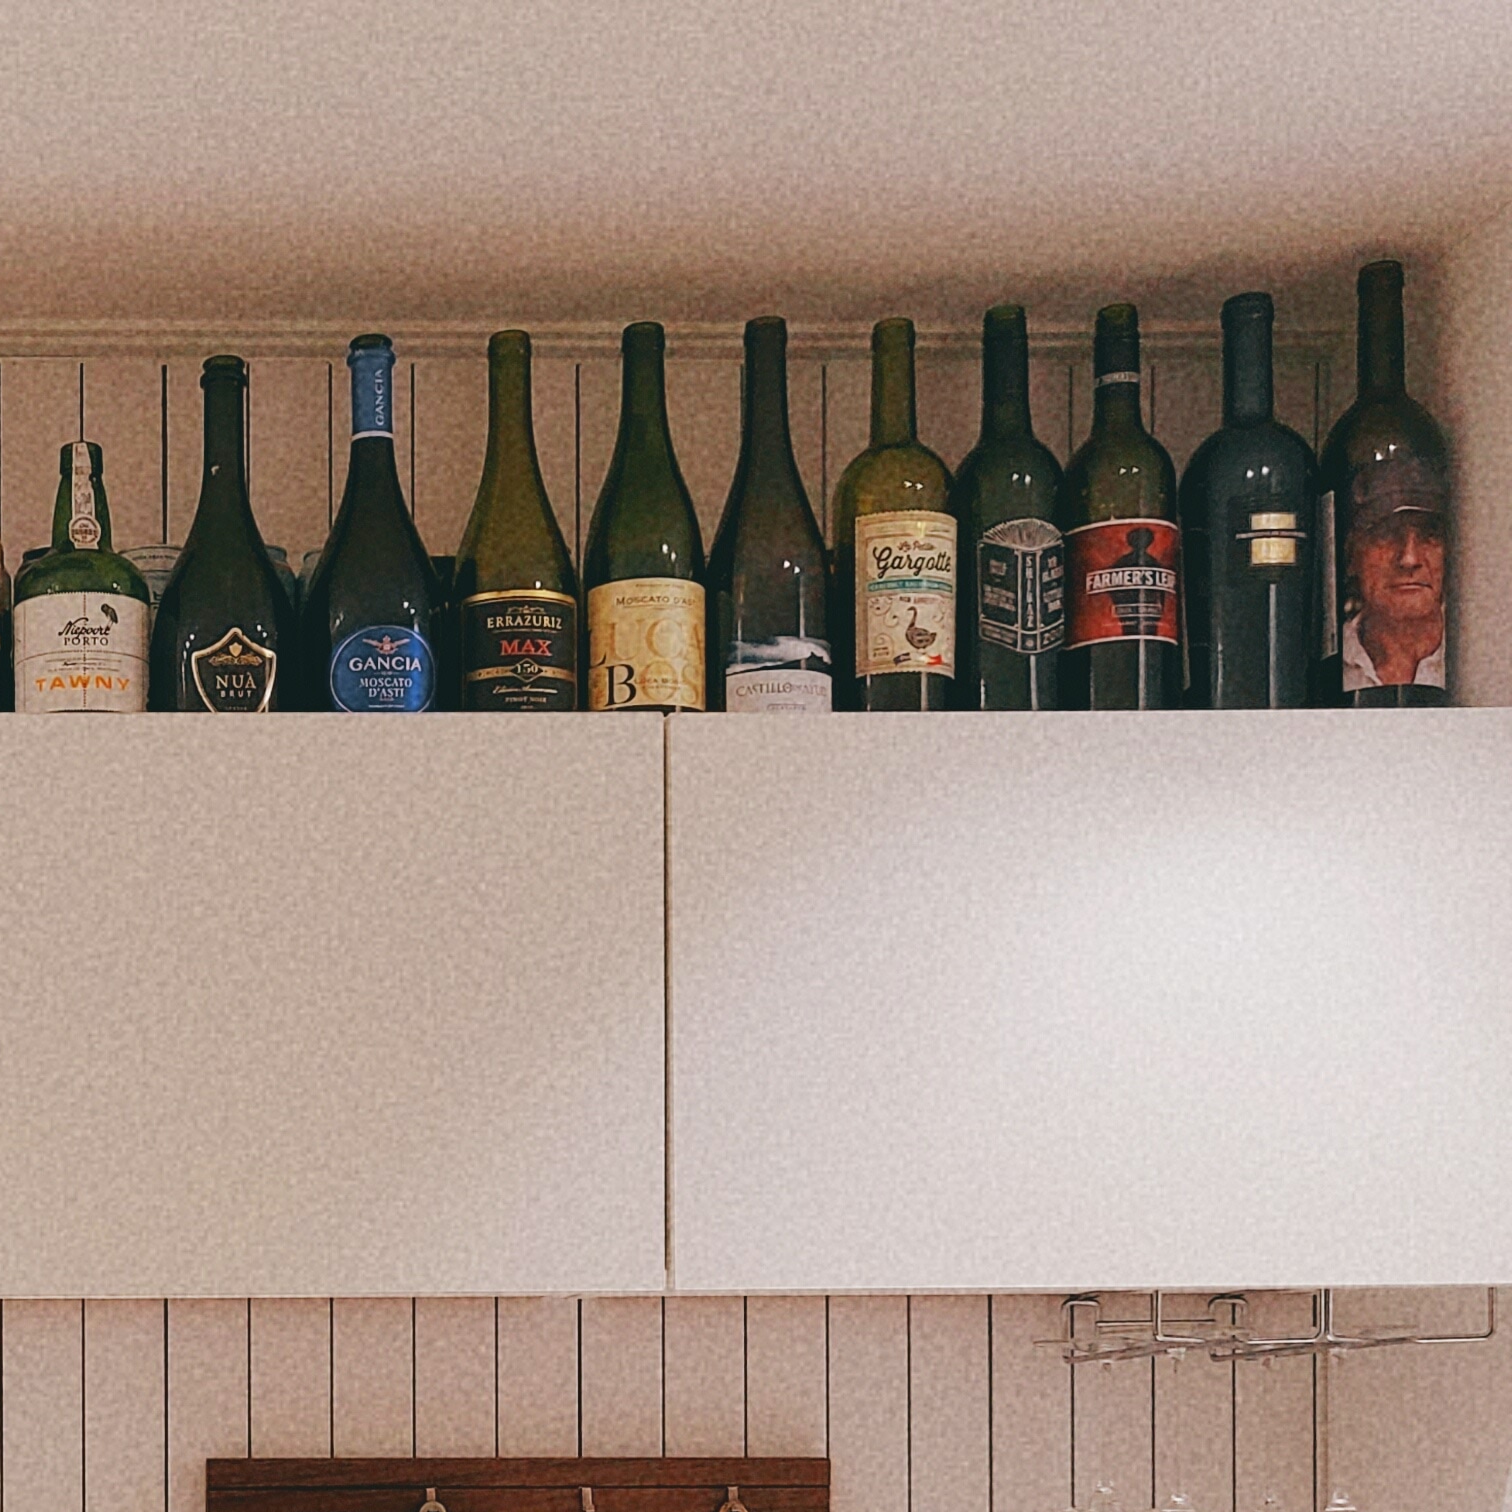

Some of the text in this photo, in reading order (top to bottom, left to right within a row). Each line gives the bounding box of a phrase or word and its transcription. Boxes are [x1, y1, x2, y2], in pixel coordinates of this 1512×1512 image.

[374, 369, 385, 426] GANCIA
[1086, 570, 1154, 590] FARMER'S
[615, 595, 671, 607] MOSCATO
[487, 615, 563, 630] ERRAZURIZ
[64, 636, 109, 646] PORTO
[500, 639, 553, 657] MAX
[349, 656, 422, 672] GANCIA
[35, 675, 131, 692] TAWNY
[215, 671, 257, 690] NUÀ
[359, 677, 413, 689] MOSCATO
[220, 690, 253, 699] BRUT
[368, 687, 405, 699] D'ASTI
[735, 682, 793, 697] CASTILLO
